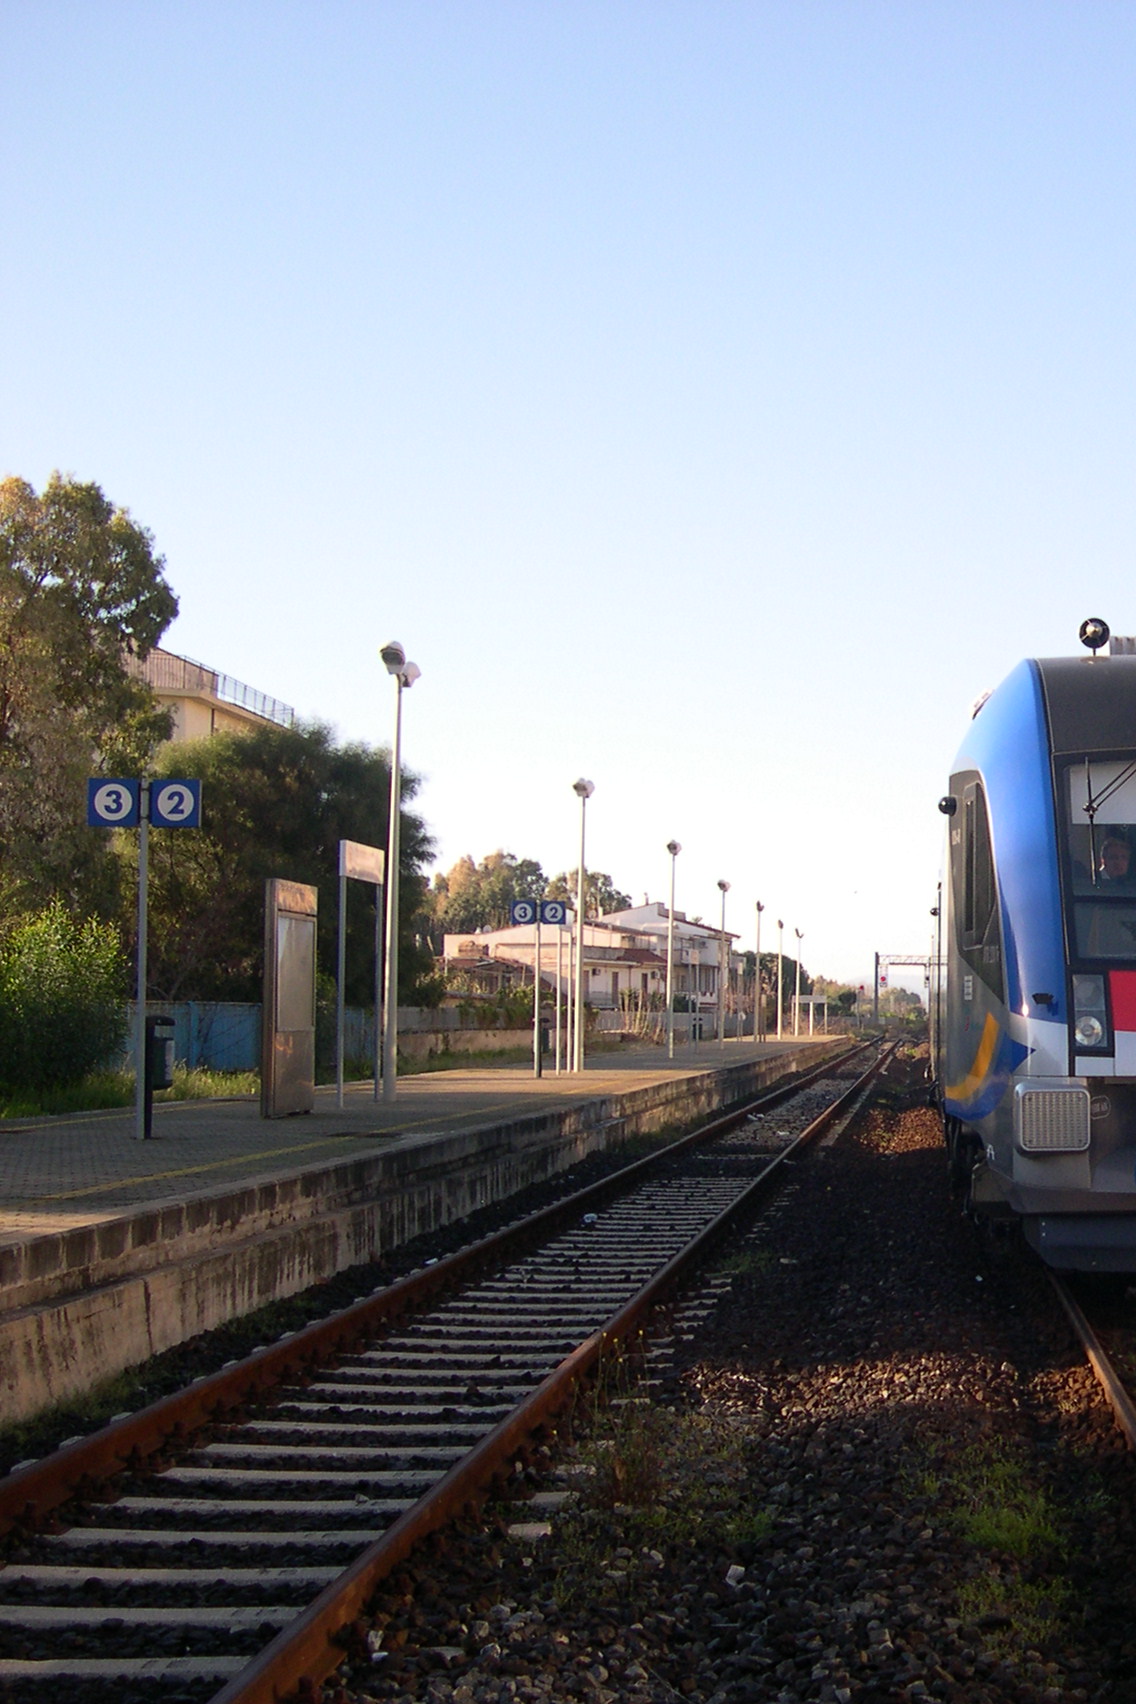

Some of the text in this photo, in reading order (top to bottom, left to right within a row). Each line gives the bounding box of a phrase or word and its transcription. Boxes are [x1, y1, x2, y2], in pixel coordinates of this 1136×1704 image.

[104, 790, 123, 814] 3
[167, 791, 185, 815] 2
[519, 906, 527, 919] 3
[550, 906, 559, 919] 2
